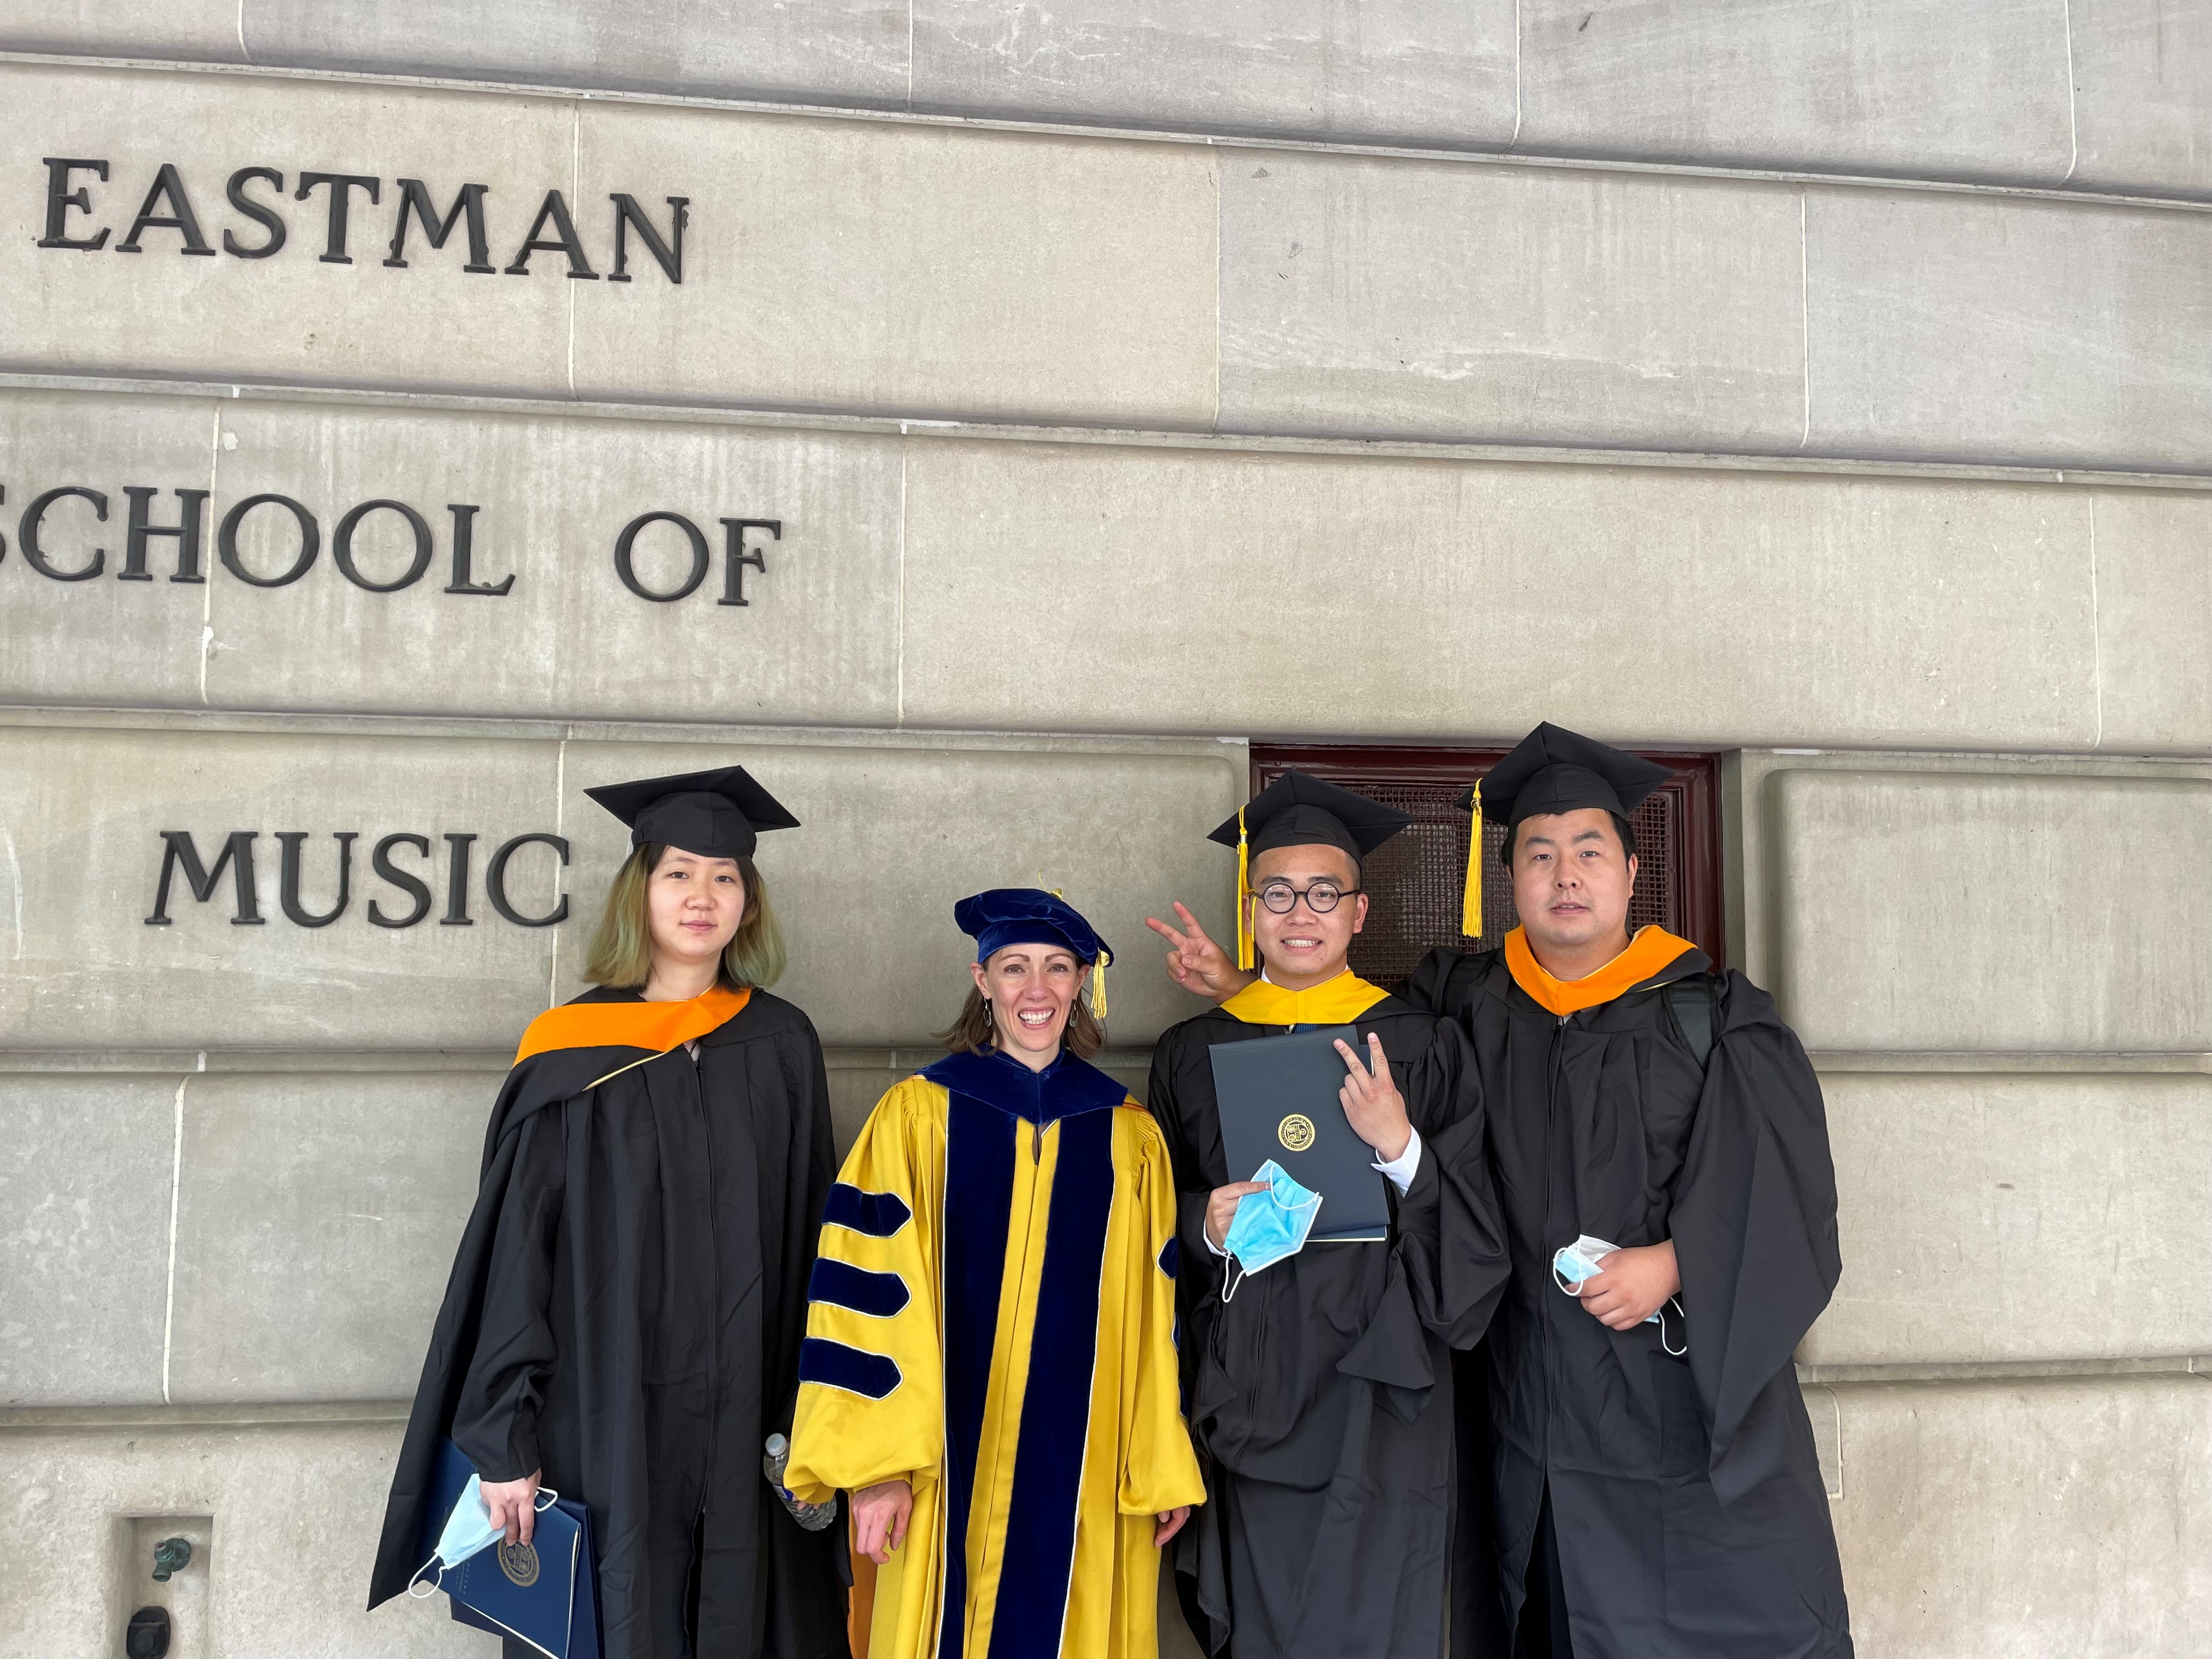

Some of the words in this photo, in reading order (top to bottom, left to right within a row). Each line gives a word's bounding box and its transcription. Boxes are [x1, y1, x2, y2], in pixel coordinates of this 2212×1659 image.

[37, 157, 690, 284] EASTMAN
[0, 486, 516, 596] CHOOL
[614, 511, 781, 607] OF
[144, 831, 570, 929] MUSIC
